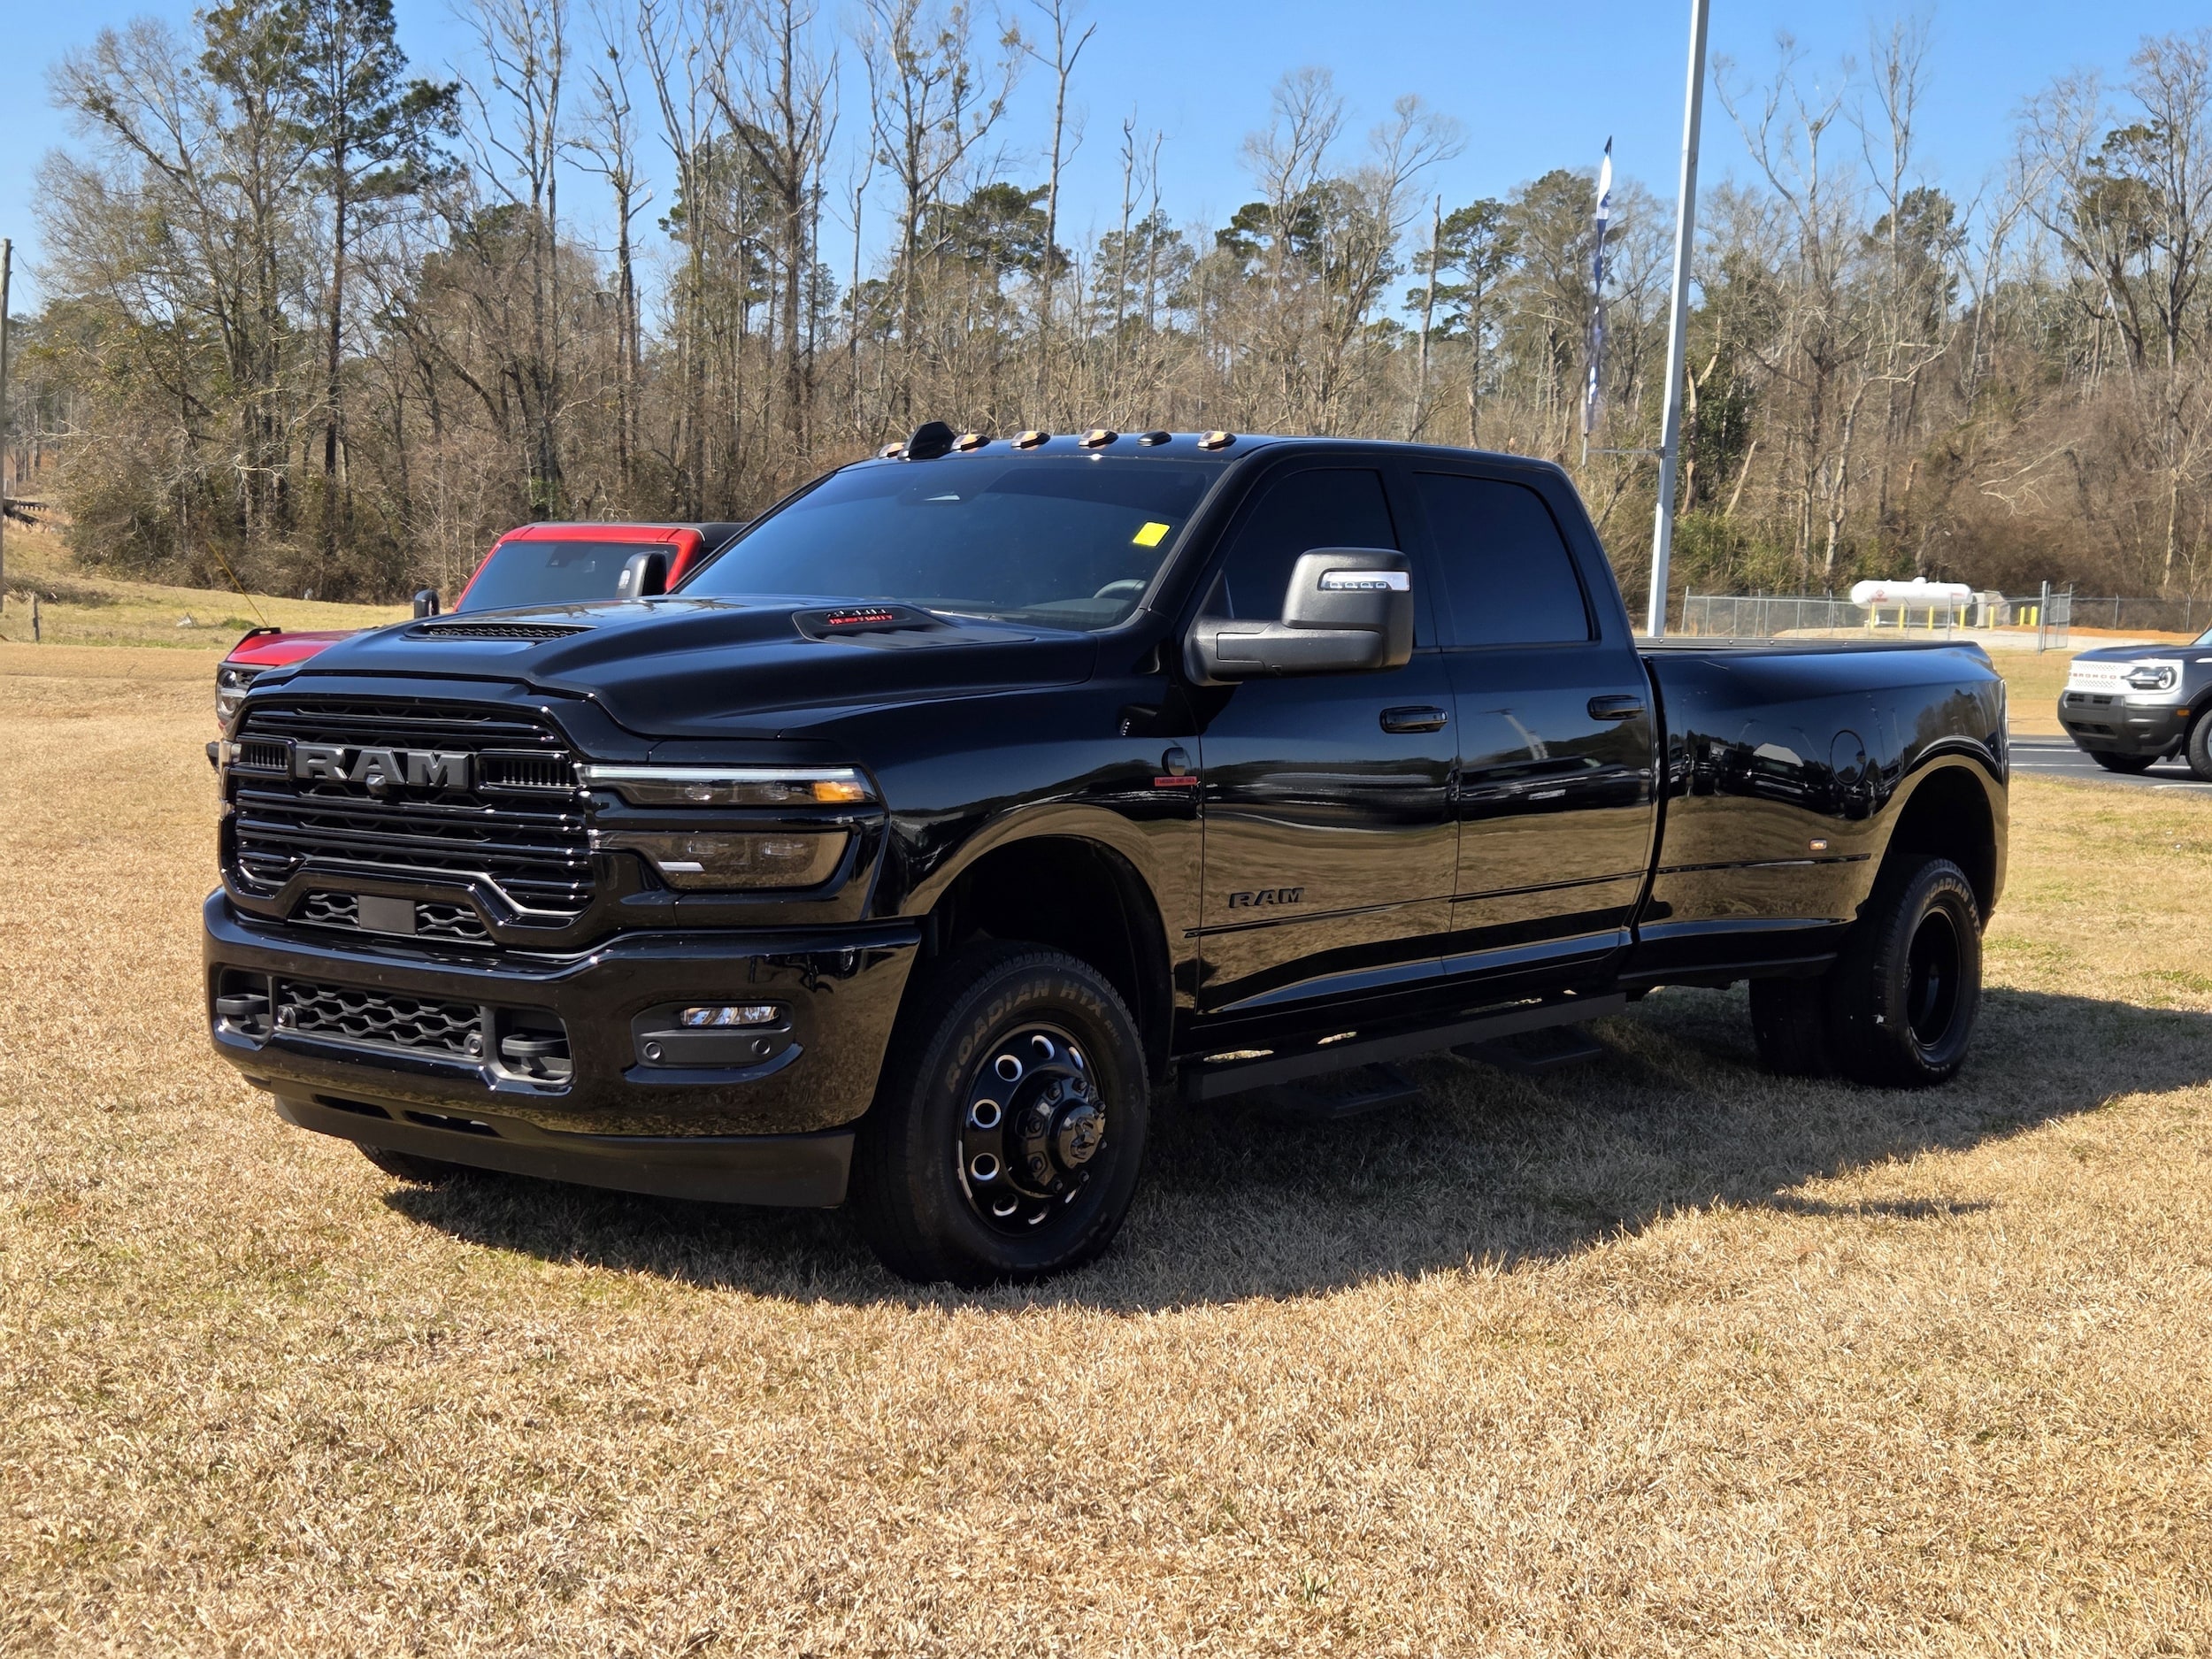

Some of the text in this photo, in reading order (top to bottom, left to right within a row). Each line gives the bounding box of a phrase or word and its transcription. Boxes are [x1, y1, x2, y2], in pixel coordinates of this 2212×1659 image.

[295, 743, 471, 790] RAM
[1228, 887, 1305, 909] RAM
[945, 978, 1051, 1094] ROADIAN
[1059, 979, 1109, 1018] HTX
